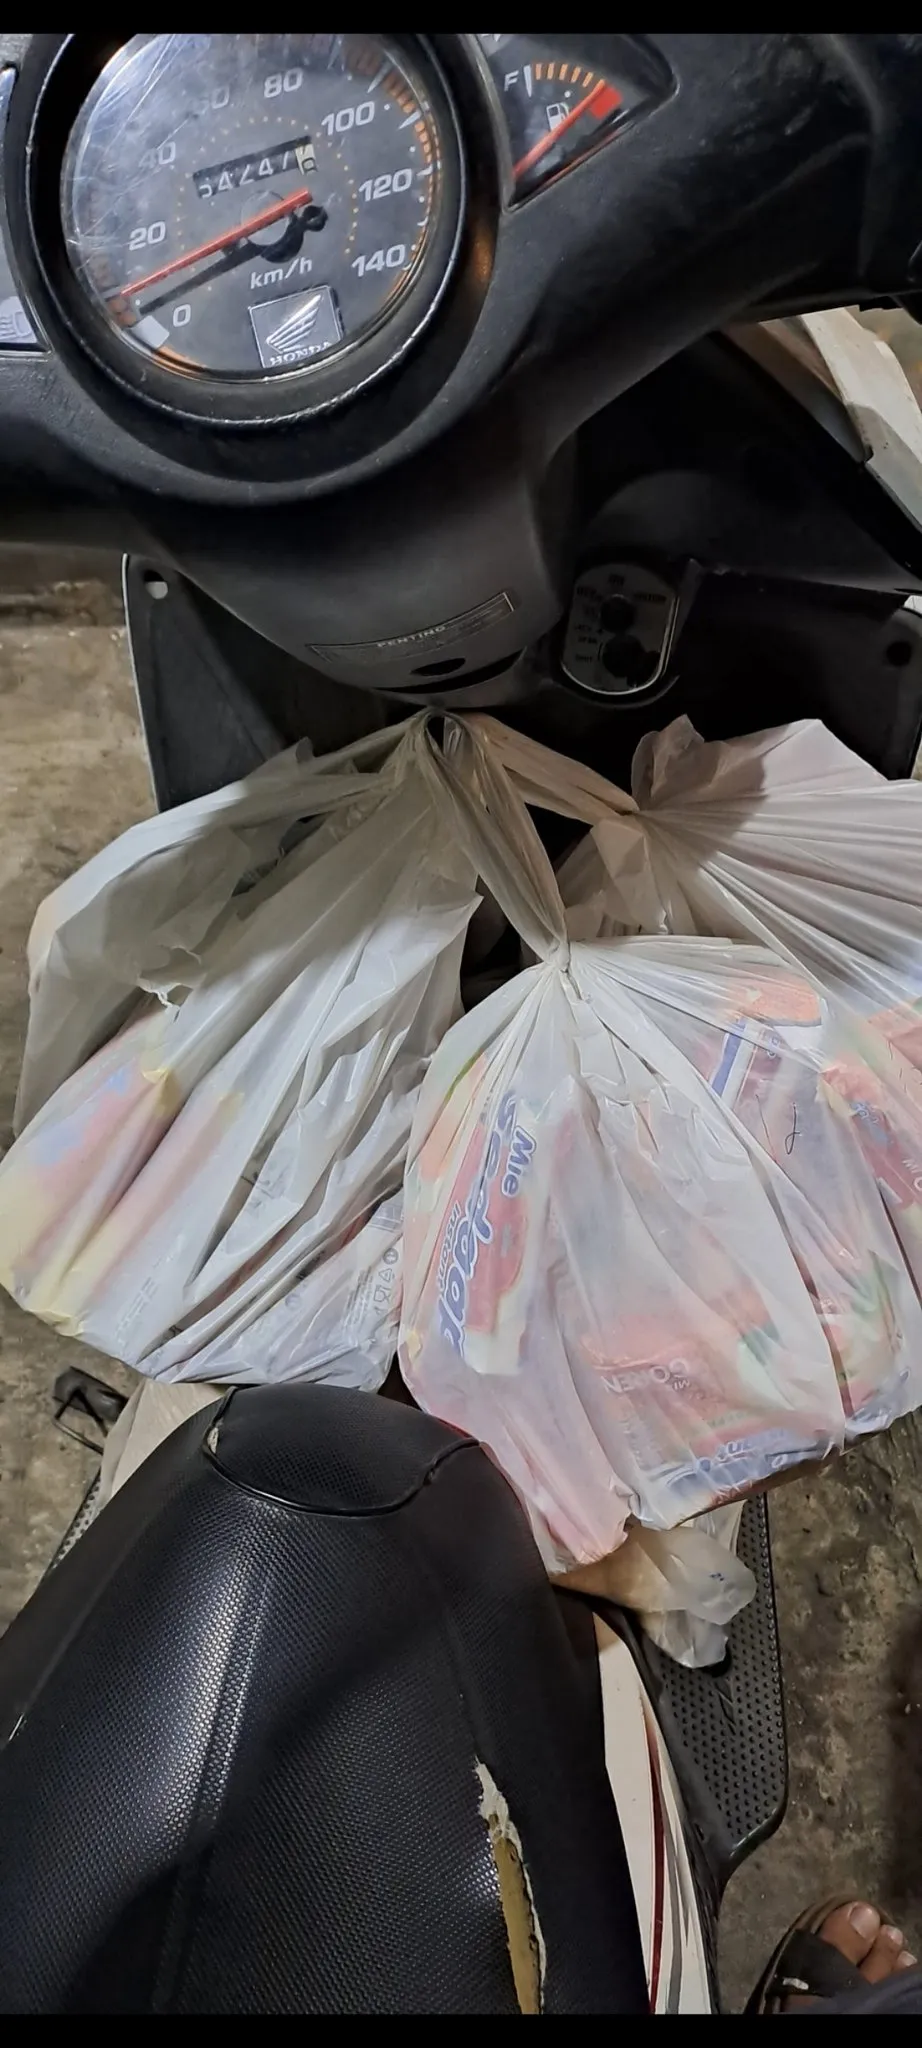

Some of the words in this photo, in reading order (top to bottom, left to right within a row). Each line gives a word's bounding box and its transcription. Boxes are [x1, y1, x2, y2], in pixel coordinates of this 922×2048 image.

[263, 70, 303, 99] 80
[503, 71, 520, 92] F
[321, 101, 376, 136] 100
[358, 170, 413, 202] 120
[128, 221, 167, 251] 20
[250, 257, 313, 289] km/h
[351, 244, 407, 277] 140
[172, 304, 193, 328] 0
[269, 341, 332, 366] HONDA
[503, 1126, 536, 1196] Mie
